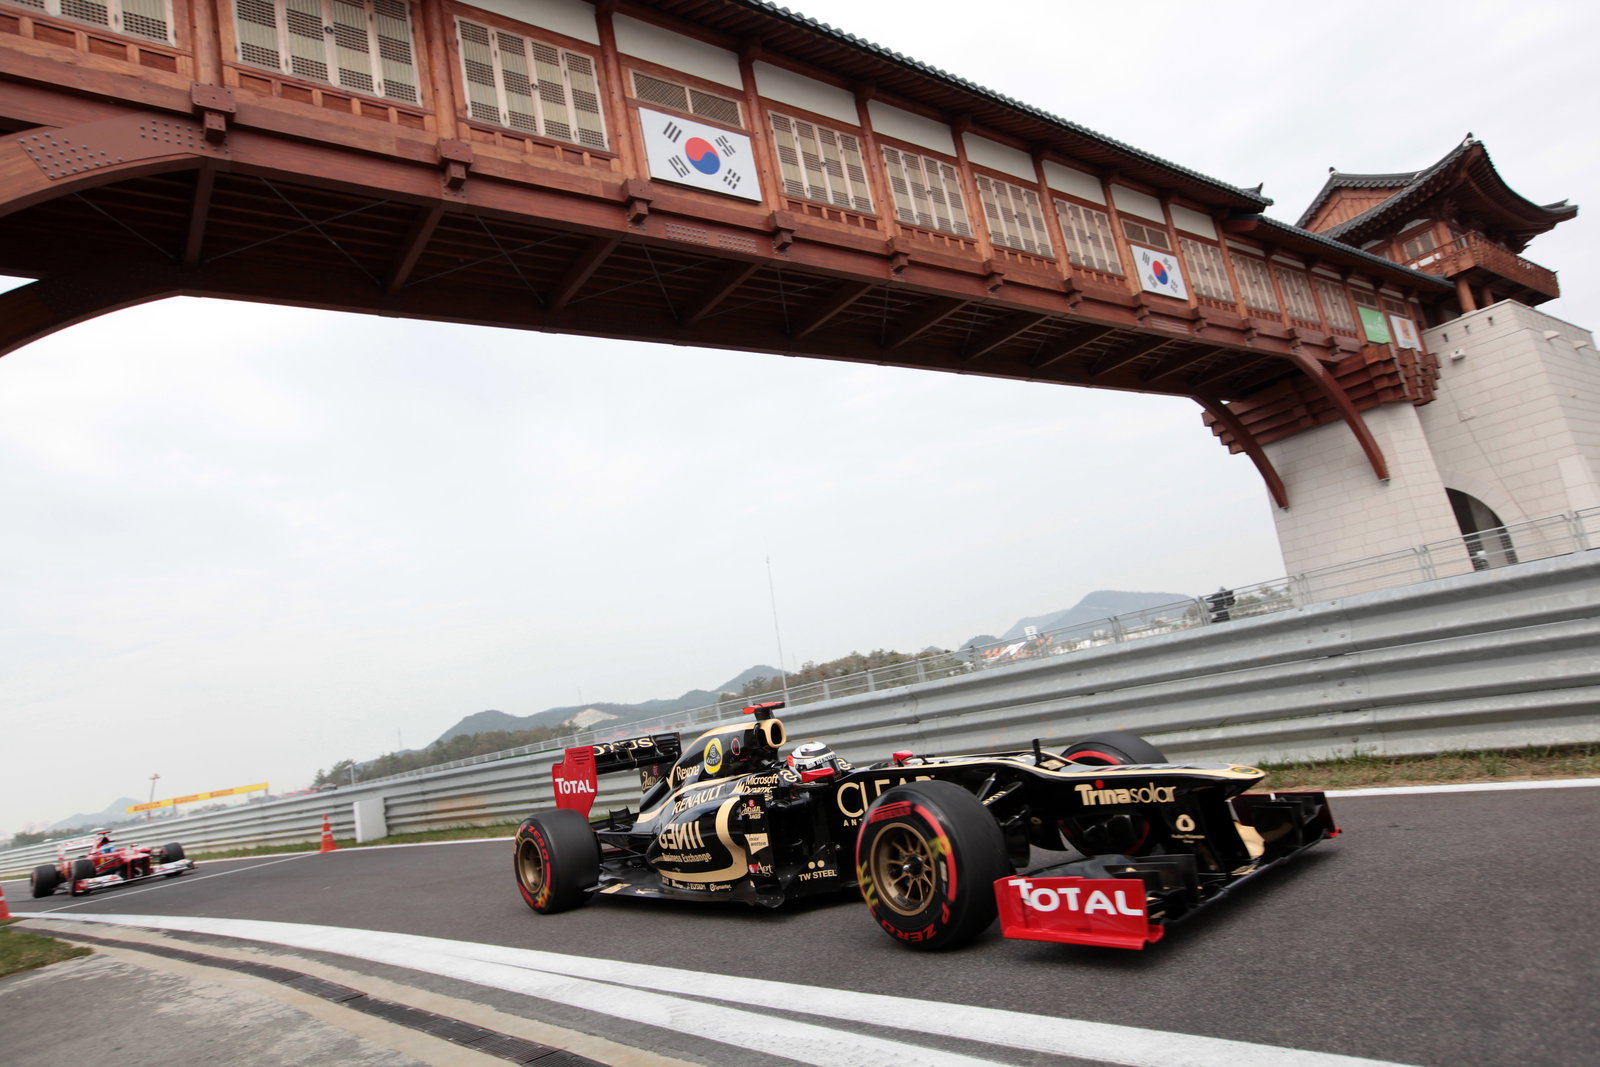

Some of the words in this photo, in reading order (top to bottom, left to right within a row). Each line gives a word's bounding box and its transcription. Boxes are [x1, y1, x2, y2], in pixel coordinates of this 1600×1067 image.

[676, 765, 700, 781] Rexona
[745, 773, 778, 785] Microsoft
[555, 777, 595, 794] TOTAL
[671, 784, 725, 816] RENAULT
[843, 818, 863, 827] AN
[799, 873, 811, 882] TW
[812, 869, 838, 880] STEEL
[1008, 878, 1145, 917] TOTAL
